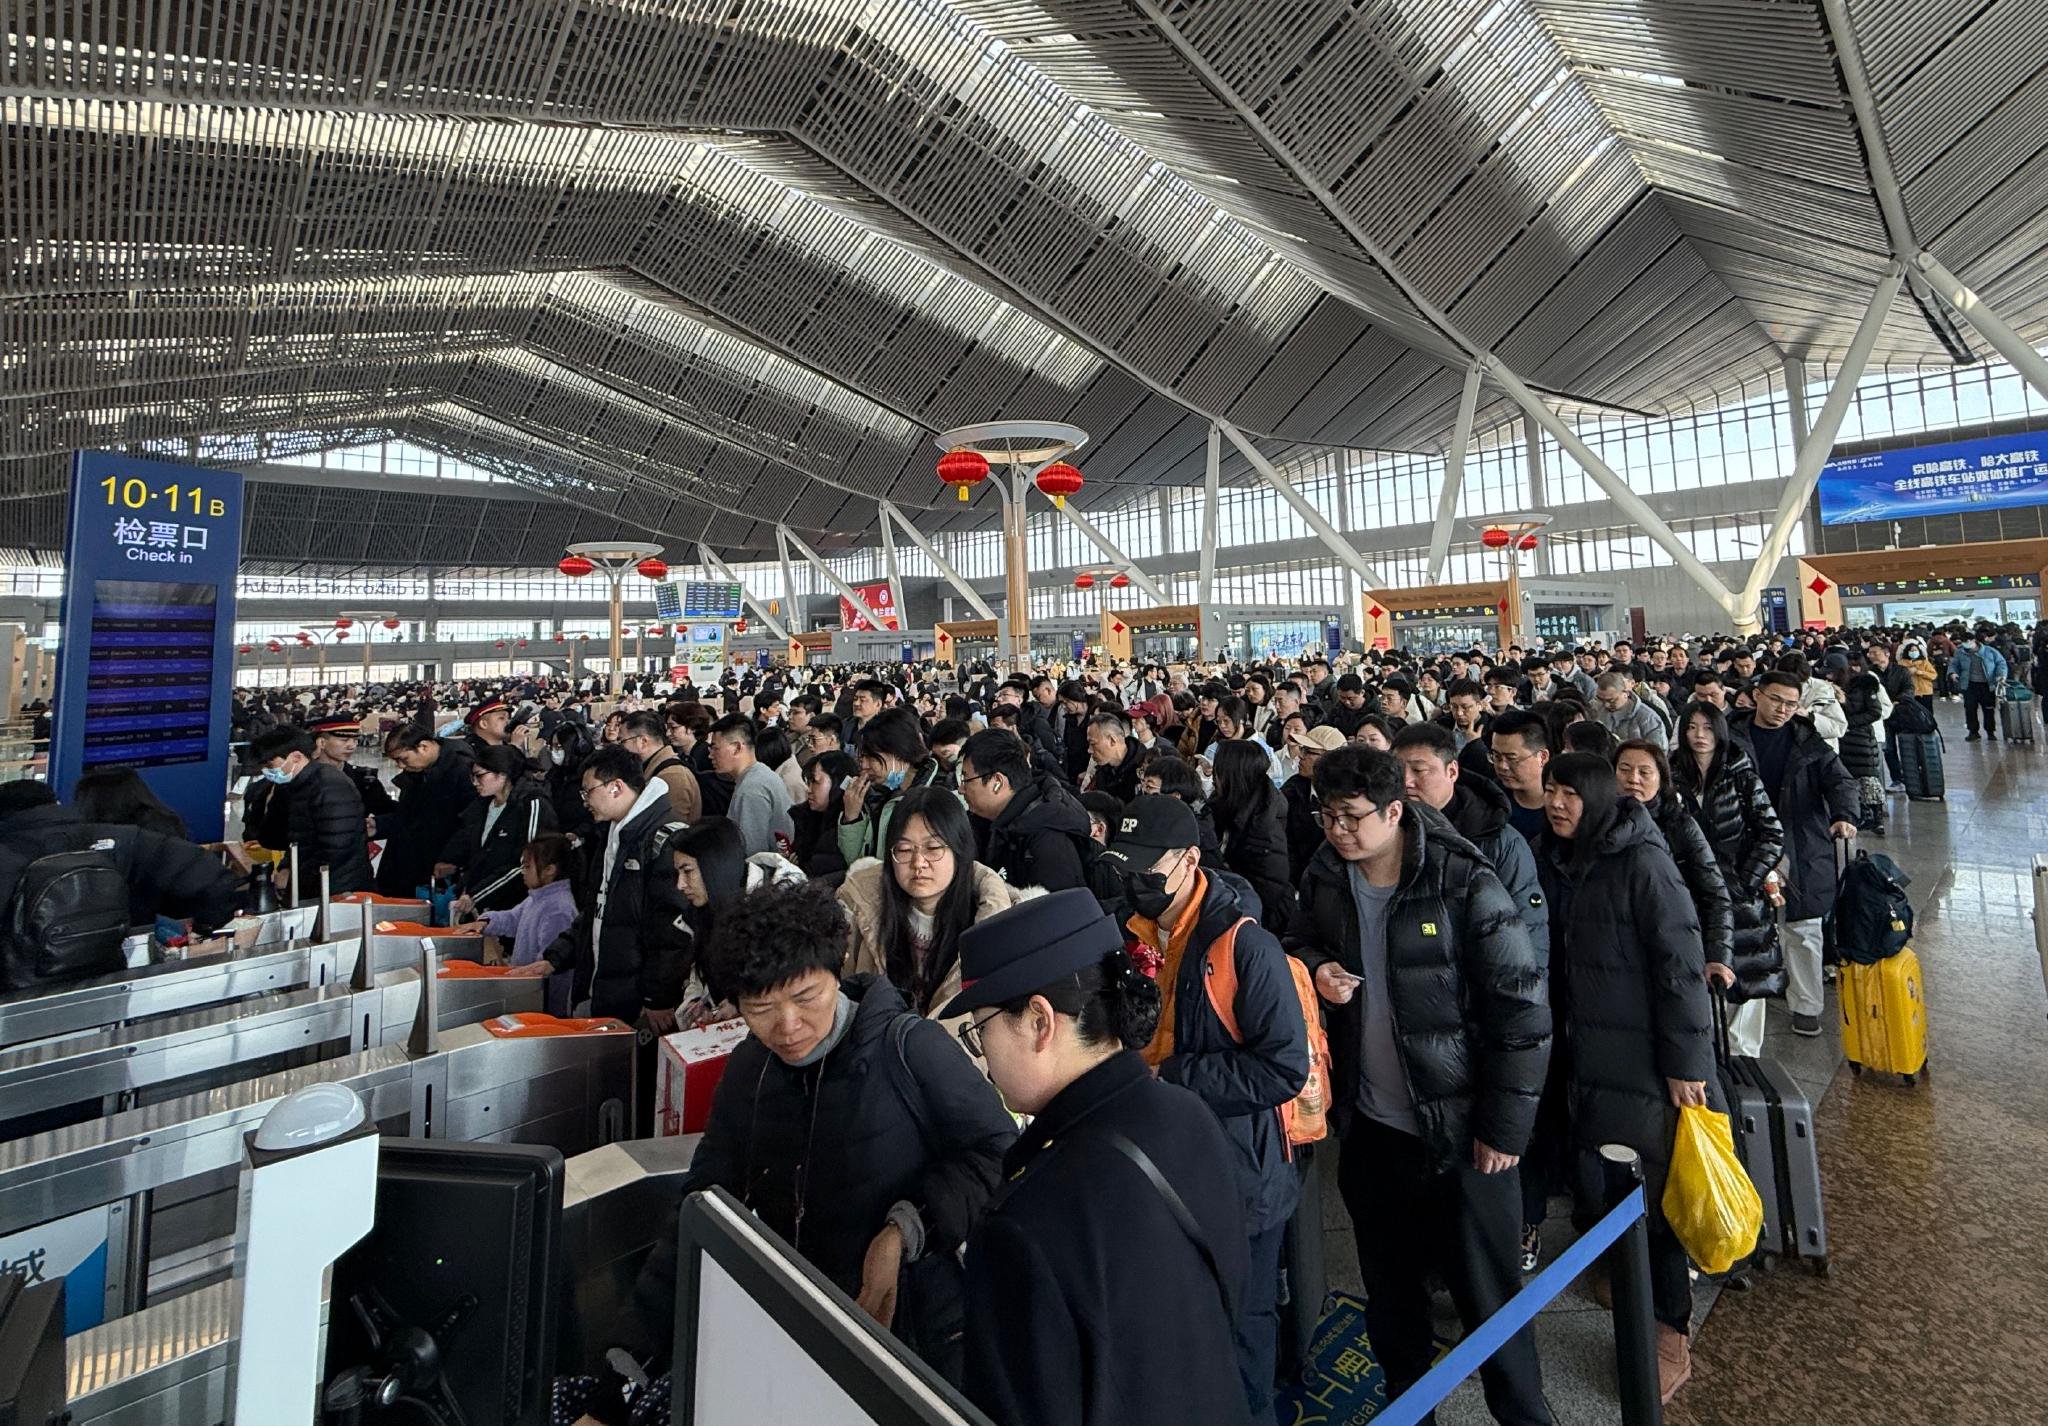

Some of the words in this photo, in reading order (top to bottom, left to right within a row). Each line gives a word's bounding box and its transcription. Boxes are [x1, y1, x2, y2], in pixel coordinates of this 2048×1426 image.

[1912, 450, 2040, 476] 京哈高铁、哈大高铁
[113, 516, 208, 550] 检票口
[126, 547, 176, 563] Check
[179, 551, 193, 564] in
[1120, 817, 1138, 833] EP
